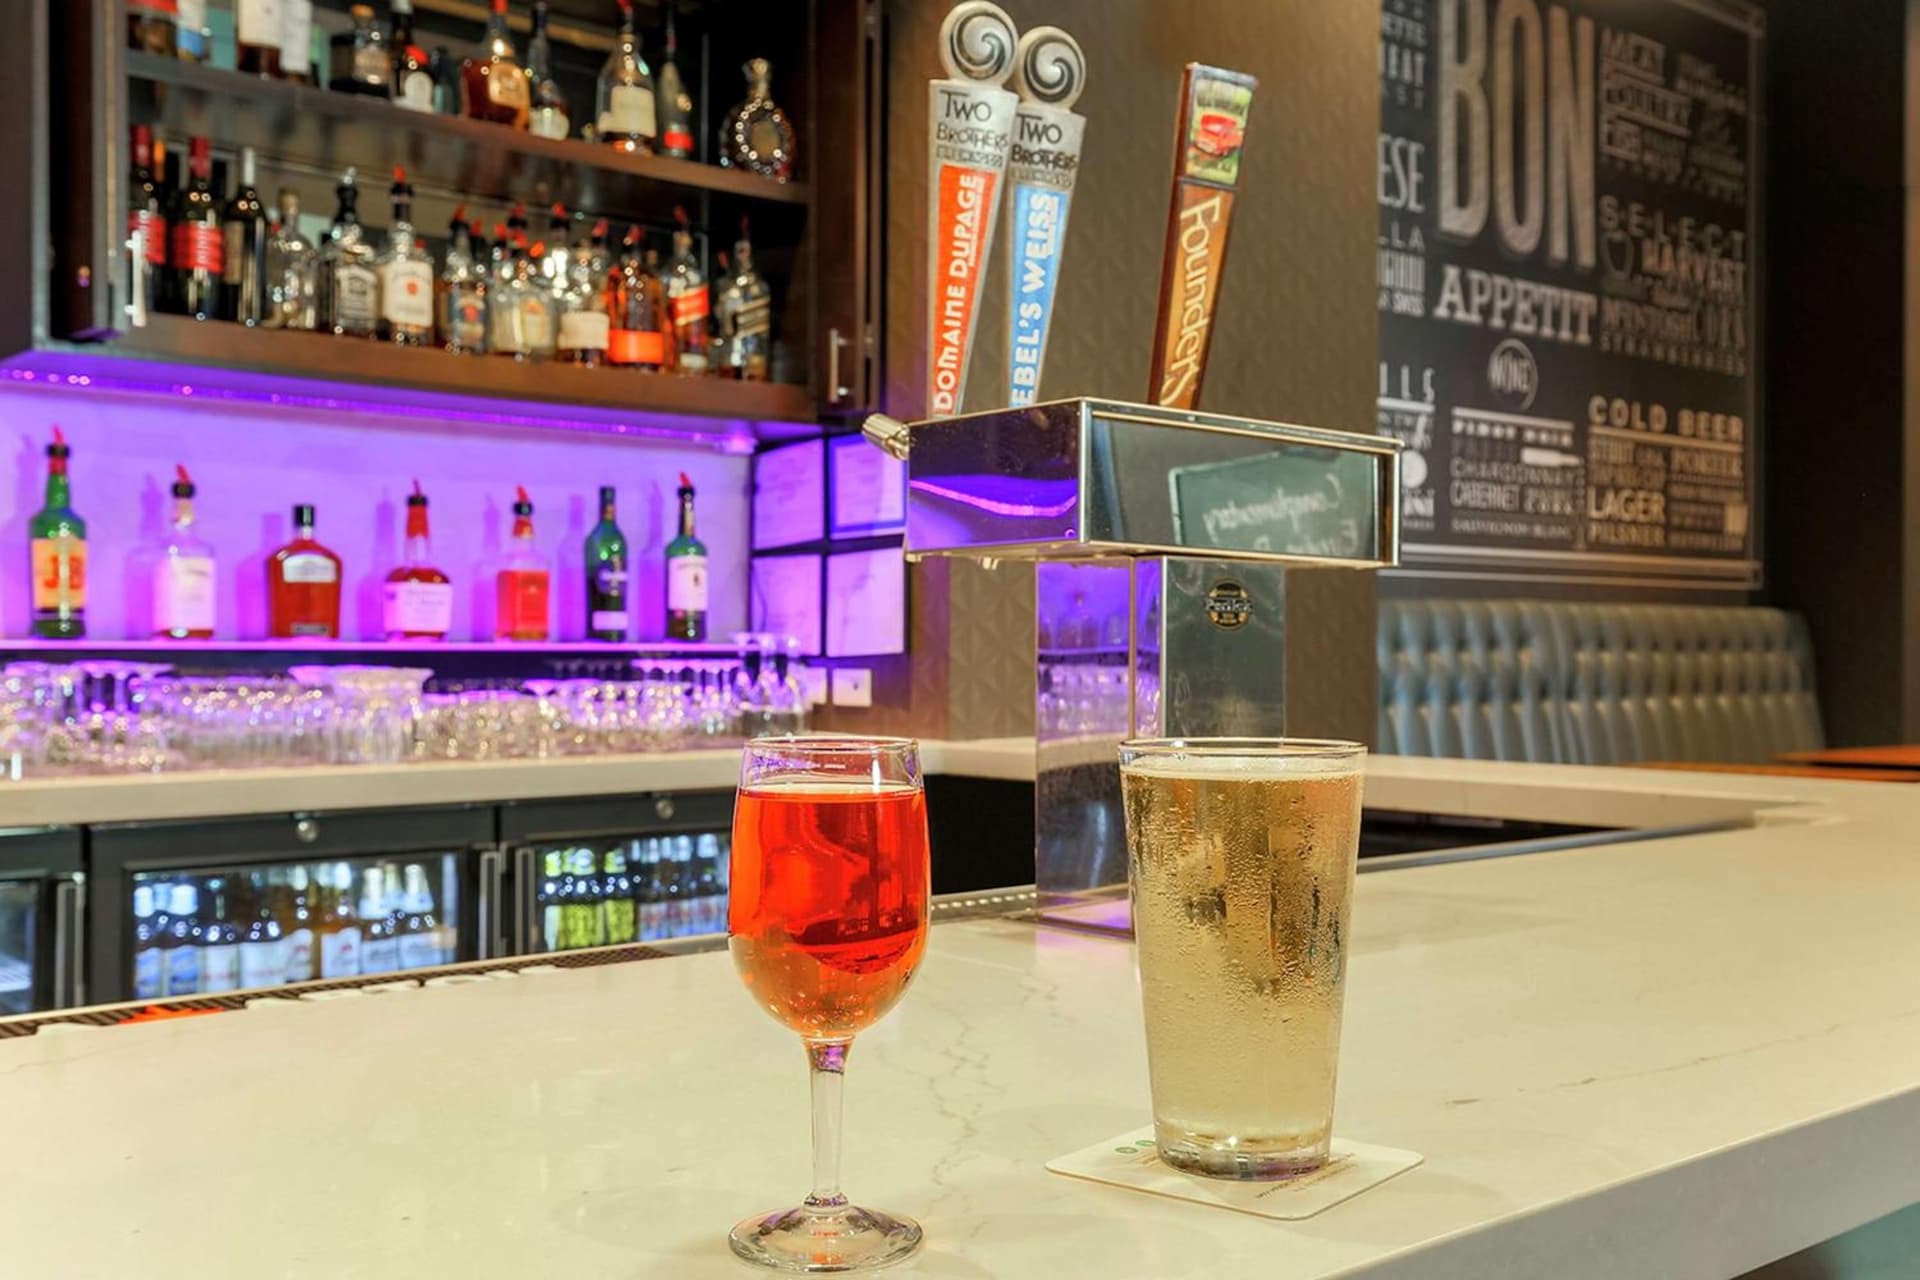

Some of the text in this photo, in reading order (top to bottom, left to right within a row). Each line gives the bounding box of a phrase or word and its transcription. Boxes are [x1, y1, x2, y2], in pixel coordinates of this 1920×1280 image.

[938, 88, 992, 122] TWO
[936, 122, 1009, 151] BROTHERS
[1016, 113, 1063, 145] TWO
[1436, 0, 1597, 271] BON
[1011, 144, 1079, 171] BROTHERS
[949, 175, 982, 280] DUPAGE
[1022, 194, 1057, 294] WEISS
[1432, 263, 1598, 346] APPETIT
[934, 284, 965, 410] DOMAINE
[1588, 395, 1744, 442] COLD BEER
[1587, 487, 1666, 523] LAGER
[1587, 521, 1666, 547] PILSNER
